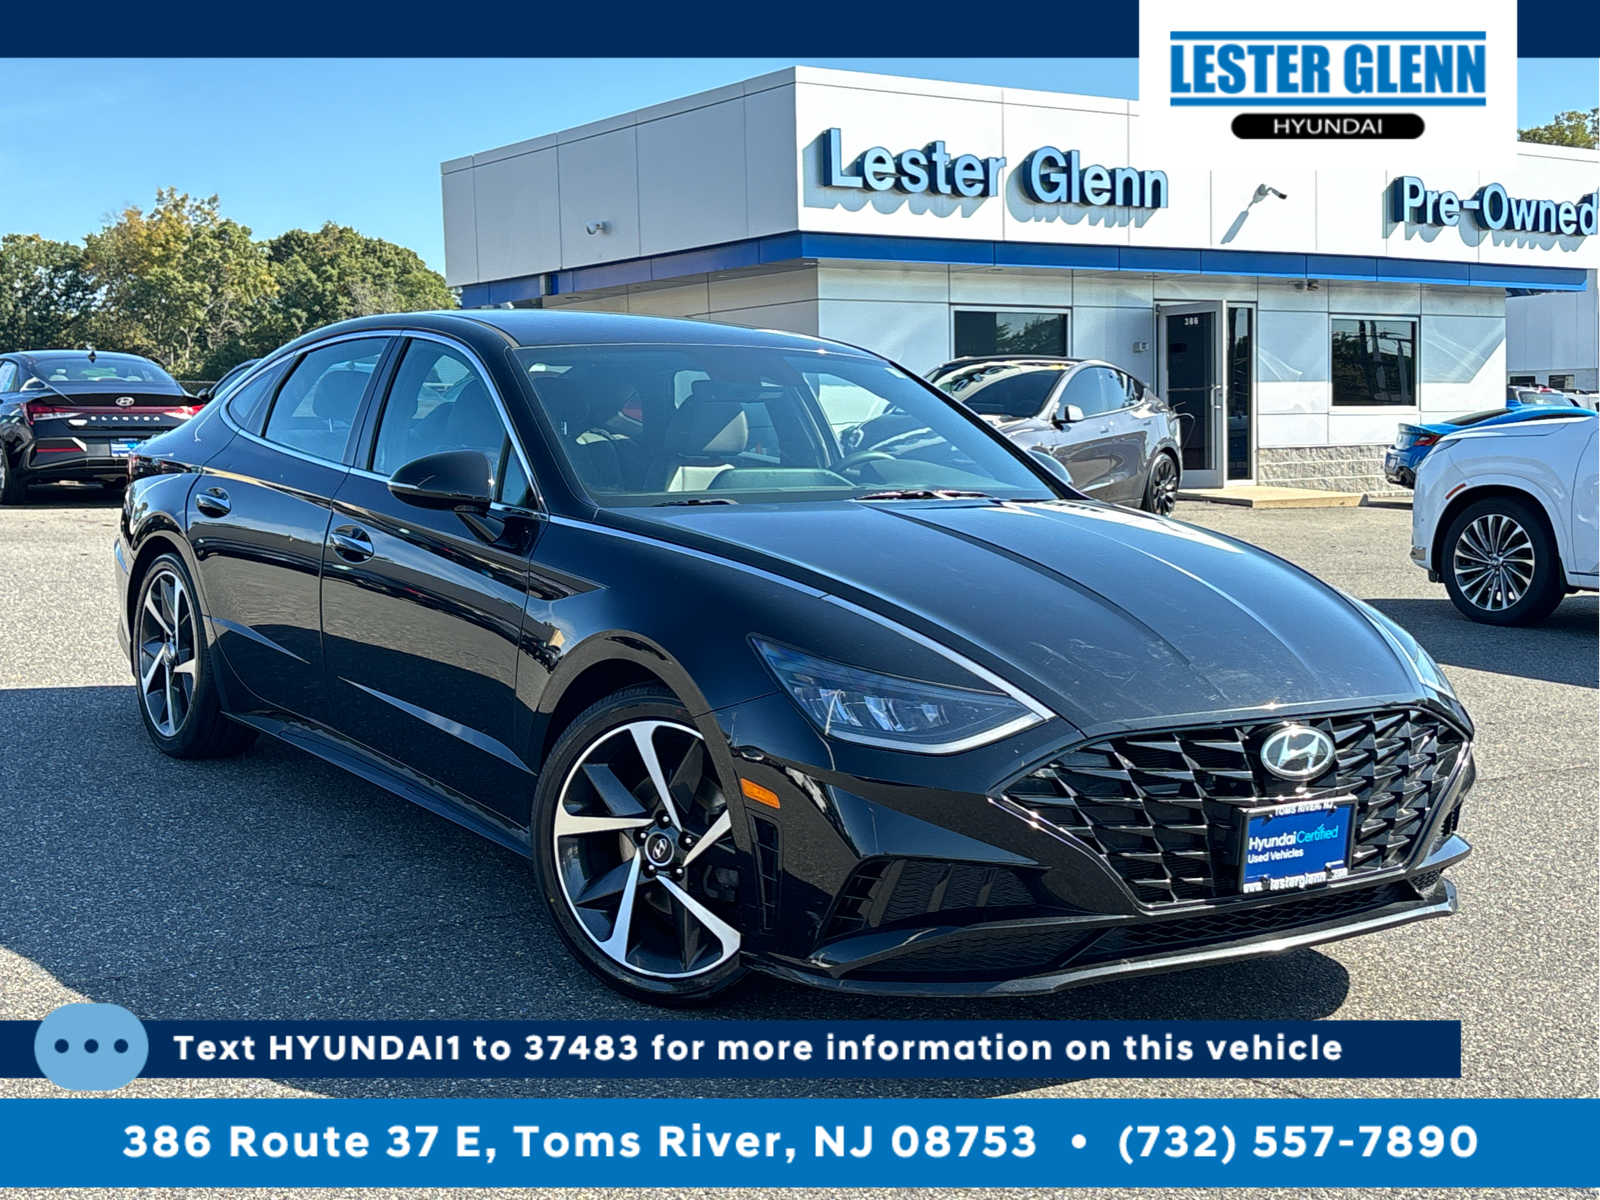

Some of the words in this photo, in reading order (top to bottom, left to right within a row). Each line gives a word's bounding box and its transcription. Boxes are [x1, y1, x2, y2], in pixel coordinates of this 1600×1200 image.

[823, 127, 1006, 199] Lester
[1021, 145, 1169, 209] Glenn
[1394, 175, 1599, 236] Pre-Owned
[1247, 853, 1269, 865] Used
[1270, 848, 1305, 861] Vehicles
